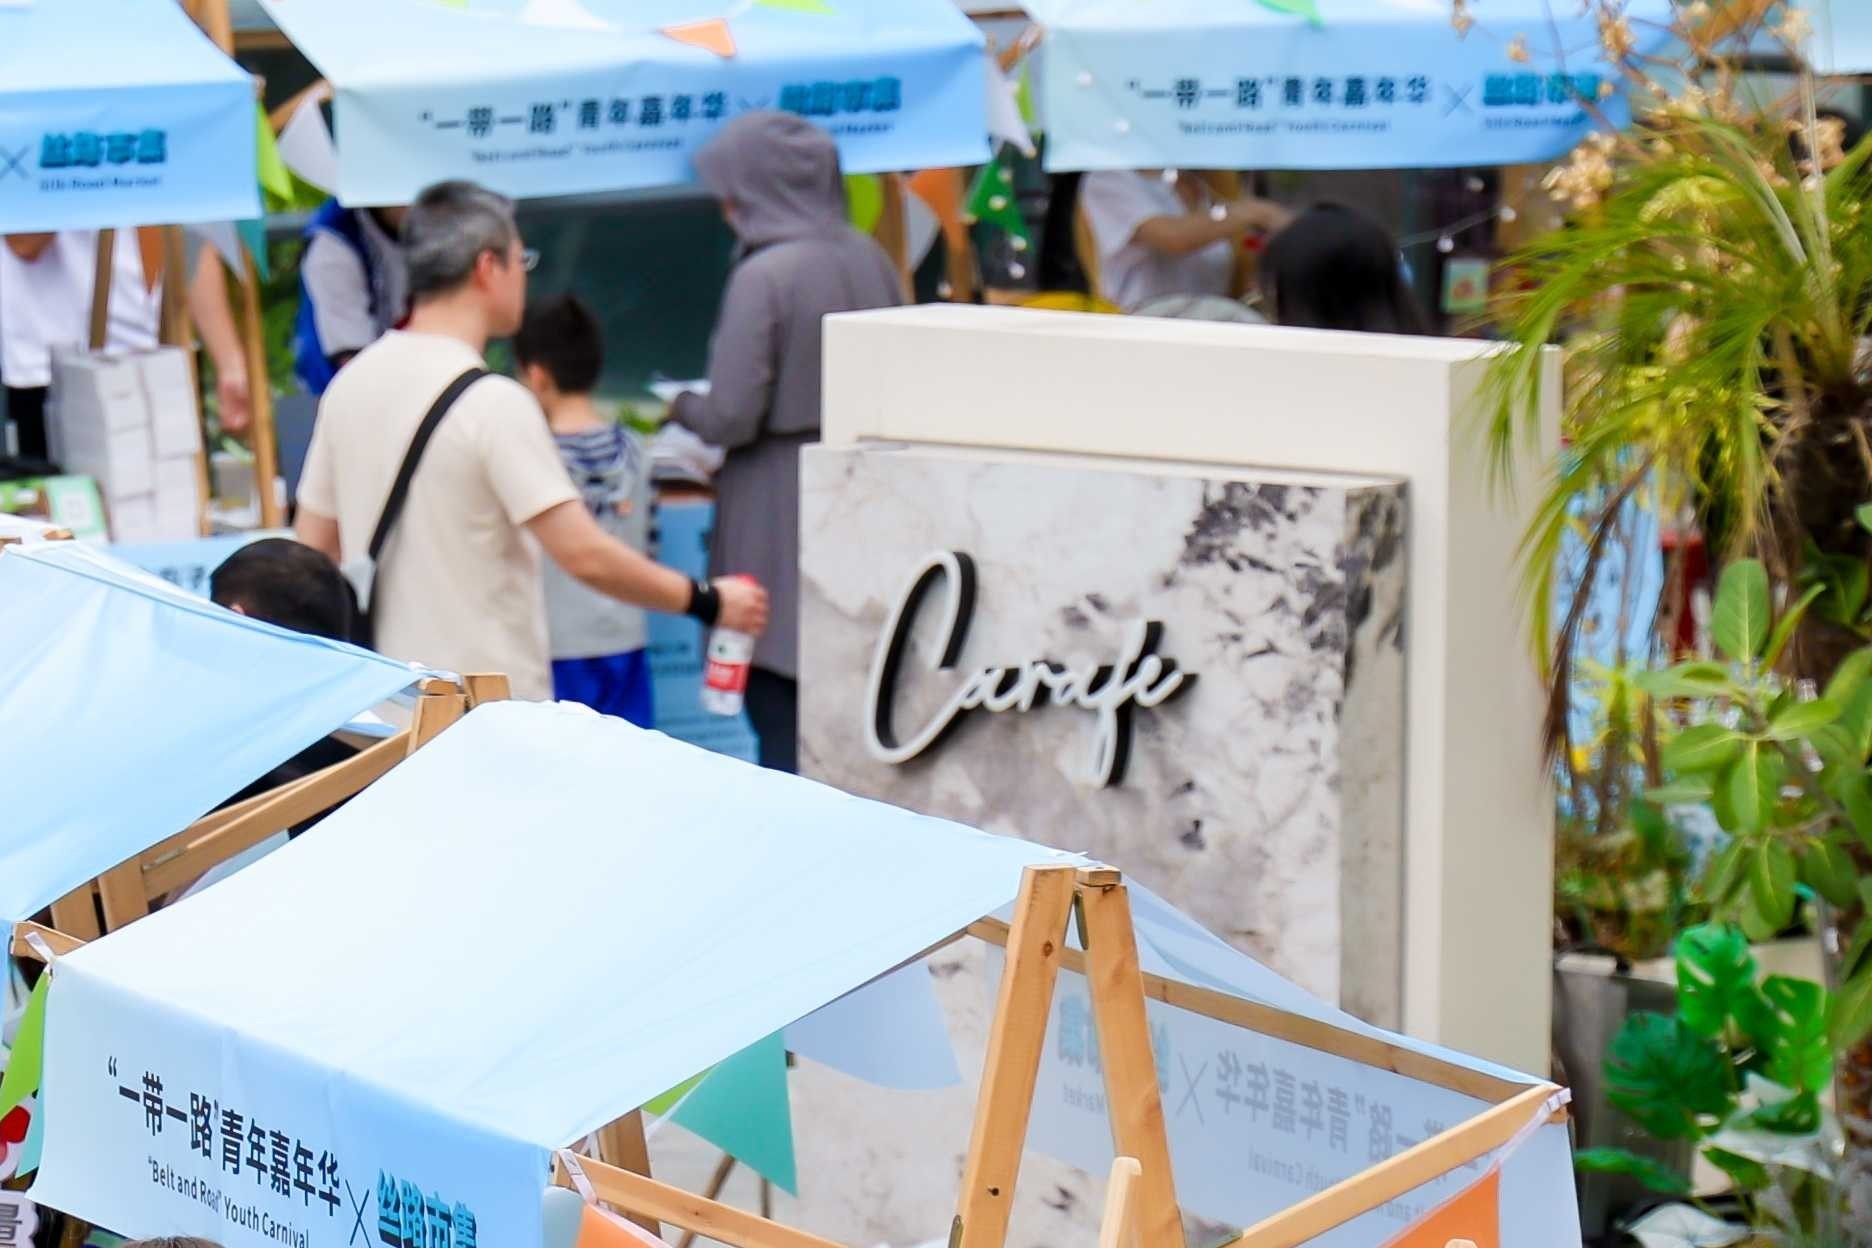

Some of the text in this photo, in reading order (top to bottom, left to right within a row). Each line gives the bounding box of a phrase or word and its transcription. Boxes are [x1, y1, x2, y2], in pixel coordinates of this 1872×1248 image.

[107, 1055, 341, 1216] “一带一路”青年嘉年华
[177, 1174, 198, 1200] and
[224, 1196, 259, 1233] Youth
